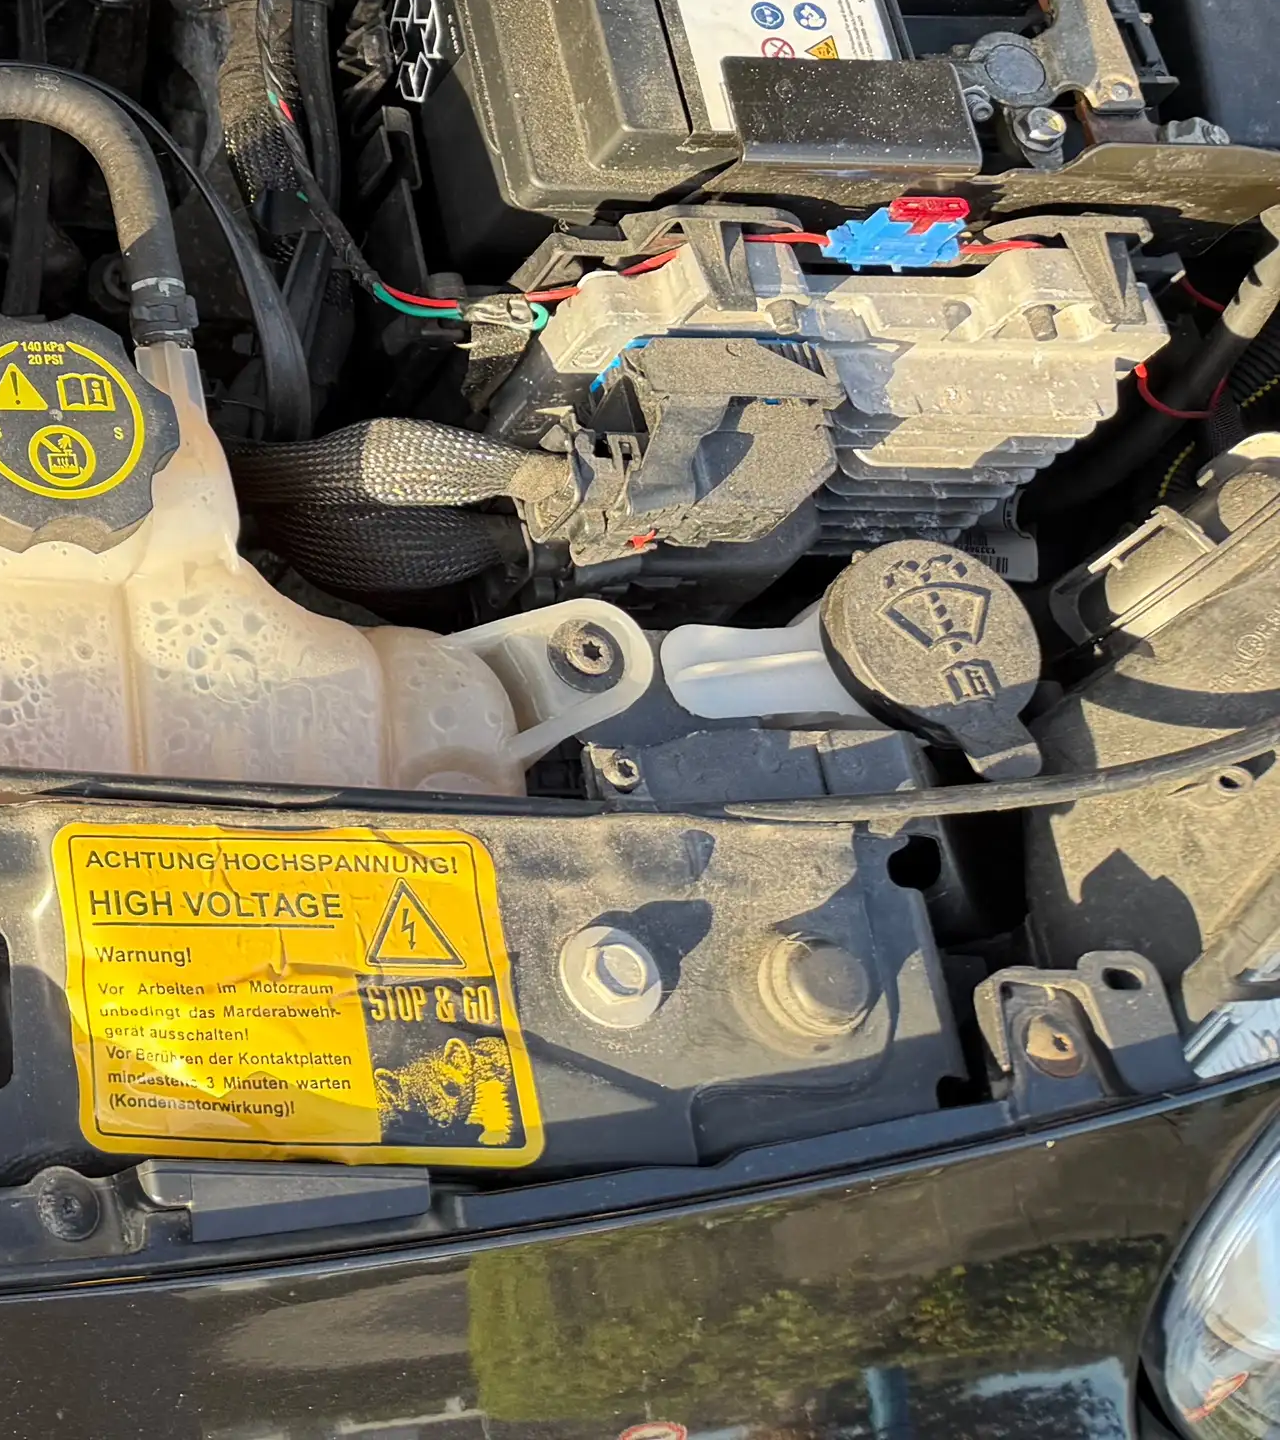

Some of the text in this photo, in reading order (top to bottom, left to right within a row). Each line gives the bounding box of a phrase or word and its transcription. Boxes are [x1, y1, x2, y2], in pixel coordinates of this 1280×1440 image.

[20, 341, 65, 353] 140 kPa
[28, 353, 63, 365] 20 PSI
[114, 426, 124, 440] S
[86, 850, 458, 874] ACHTUNG HOCHSPANNUNG!
[90, 890, 344, 919] HIGH VOLTAGE
[95, 946, 192, 967] Warnung!
[98, 980, 334, 995] Vor Arbeiten im Motorraum
[99, 1005, 341, 1020] unbedingt das Marderabwehr-
[366, 984, 496, 1025] STOP & GO
[104, 1025, 249, 1041] gerät ausschalten!
[105, 1045, 132, 1060] Vor
[209, 1052, 234, 1065] der
[239, 1051, 352, 1068] Kontaktplatten
[207, 1076, 215, 1089] 3
[223, 1076, 289, 1090] Minuten
[296, 1077, 352, 1090] warten
[109, 1093, 295, 1117] (Kondensatorwirkung)!
